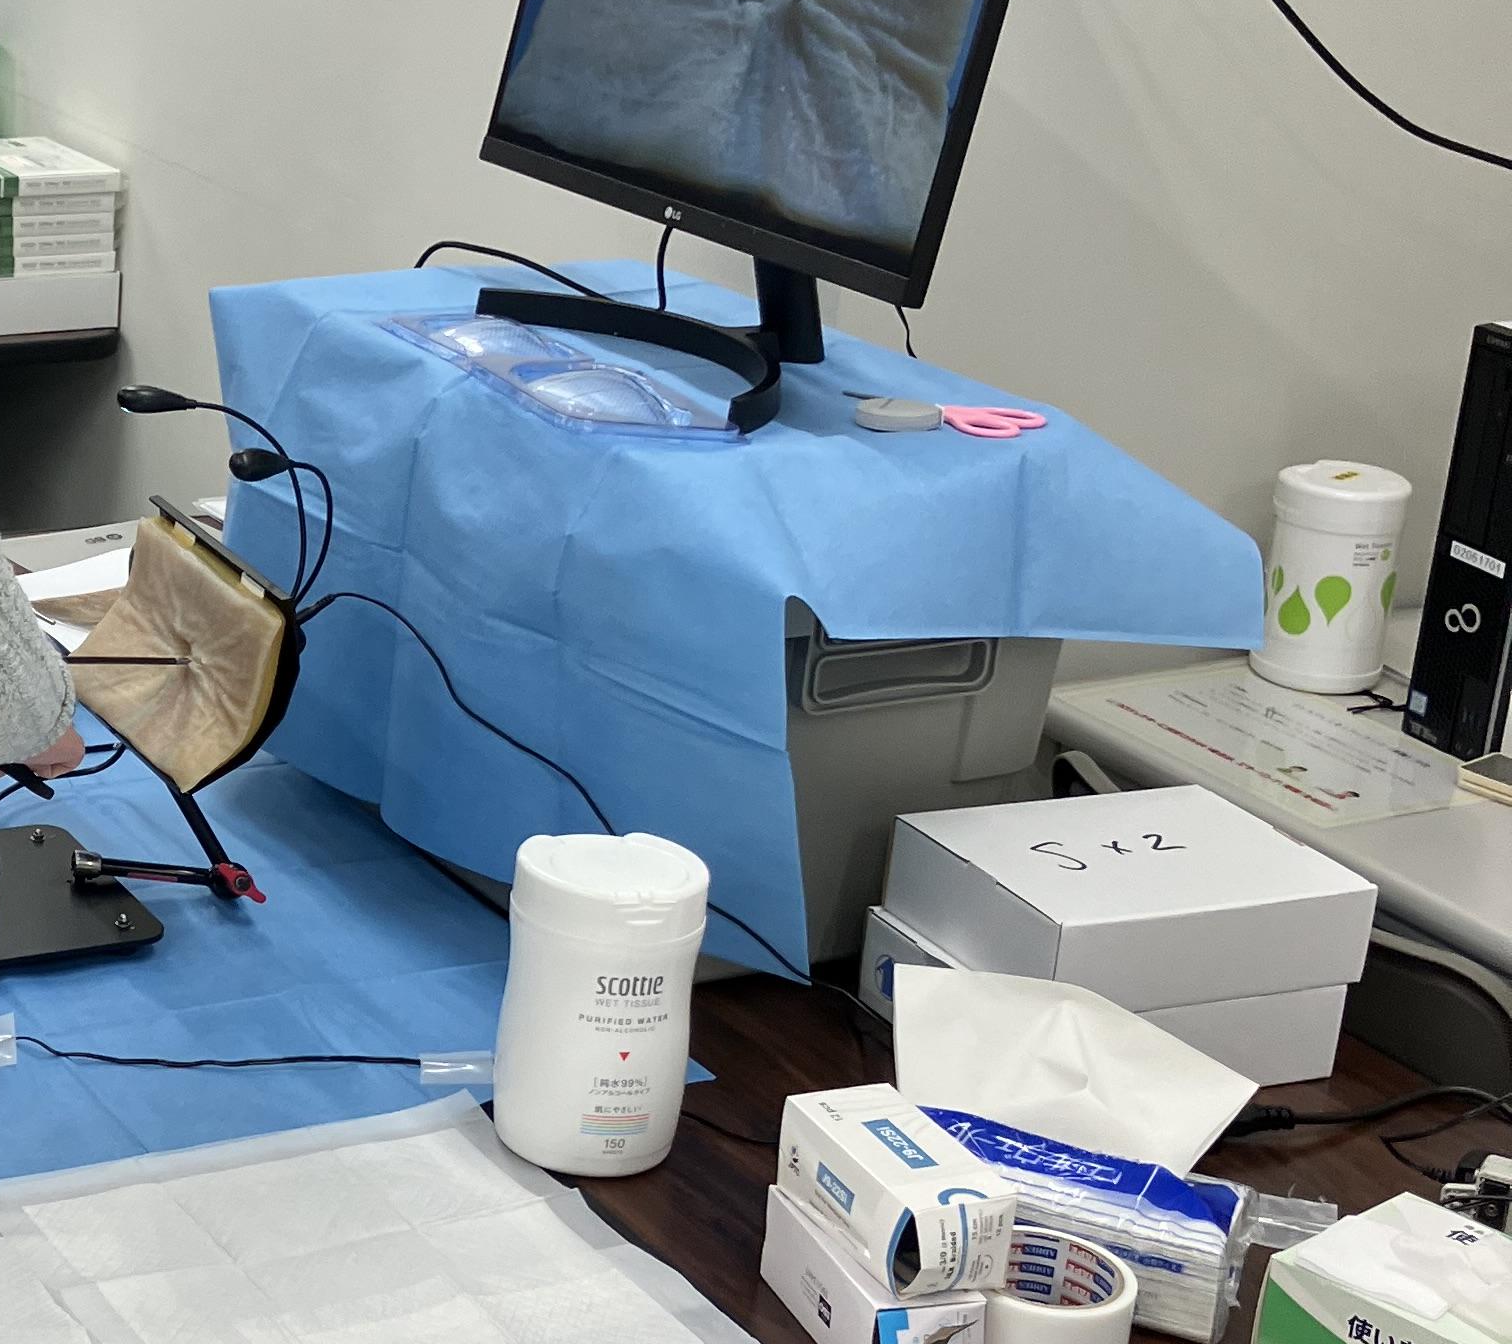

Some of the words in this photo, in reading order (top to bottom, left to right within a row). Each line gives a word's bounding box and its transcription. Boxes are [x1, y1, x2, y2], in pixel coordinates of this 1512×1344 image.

[595, 998, 620, 1008] WET
[624, 997, 662, 1009] TISSUE
[578, 1013, 632, 1026] PURIFIED
[637, 1013, 668, 1025] WATER
[604, 1138, 626, 1149] 150
